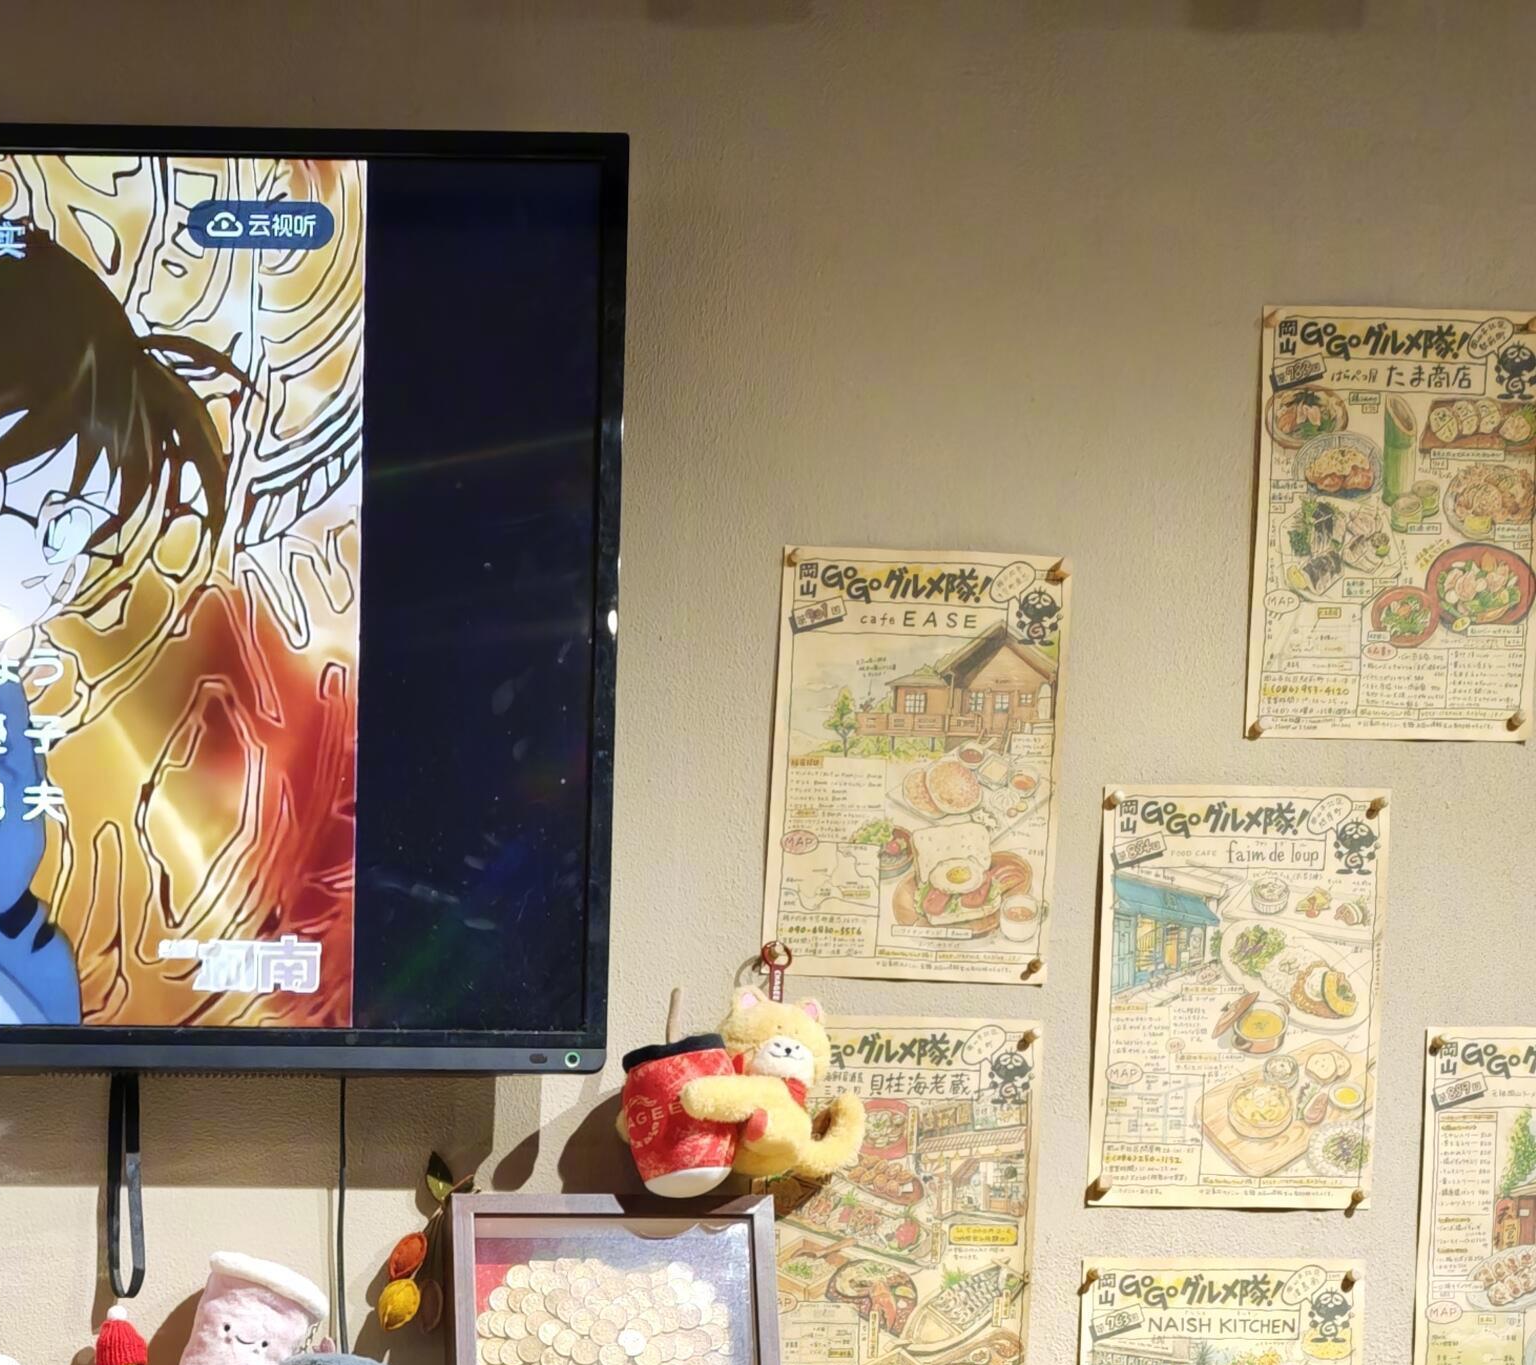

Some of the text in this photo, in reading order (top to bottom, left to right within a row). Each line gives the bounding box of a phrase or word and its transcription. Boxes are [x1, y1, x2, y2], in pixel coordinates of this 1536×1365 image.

[248, 213, 317, 238] 云视听
[1278, 320, 1297, 355] 岡山
[1386, 365, 1472, 390] たま商店
[800, 562, 818, 598] 岡山
[903, 611, 977, 629] EASE
[1120, 800, 1138, 834] 岡山
[1228, 841, 1265, 864] faim
[1269, 842, 1285, 863] de
[1290, 842, 1320, 868] loup
[1440, 1041, 1458, 1075] 岡山
[1110, 1068, 1138, 1078] MAP
[1098, 1273, 1116, 1307] 岡山
[1148, 1316, 1295, 1334] NAISH KITCHEN
[1429, 1309, 1457, 1318] MAP
